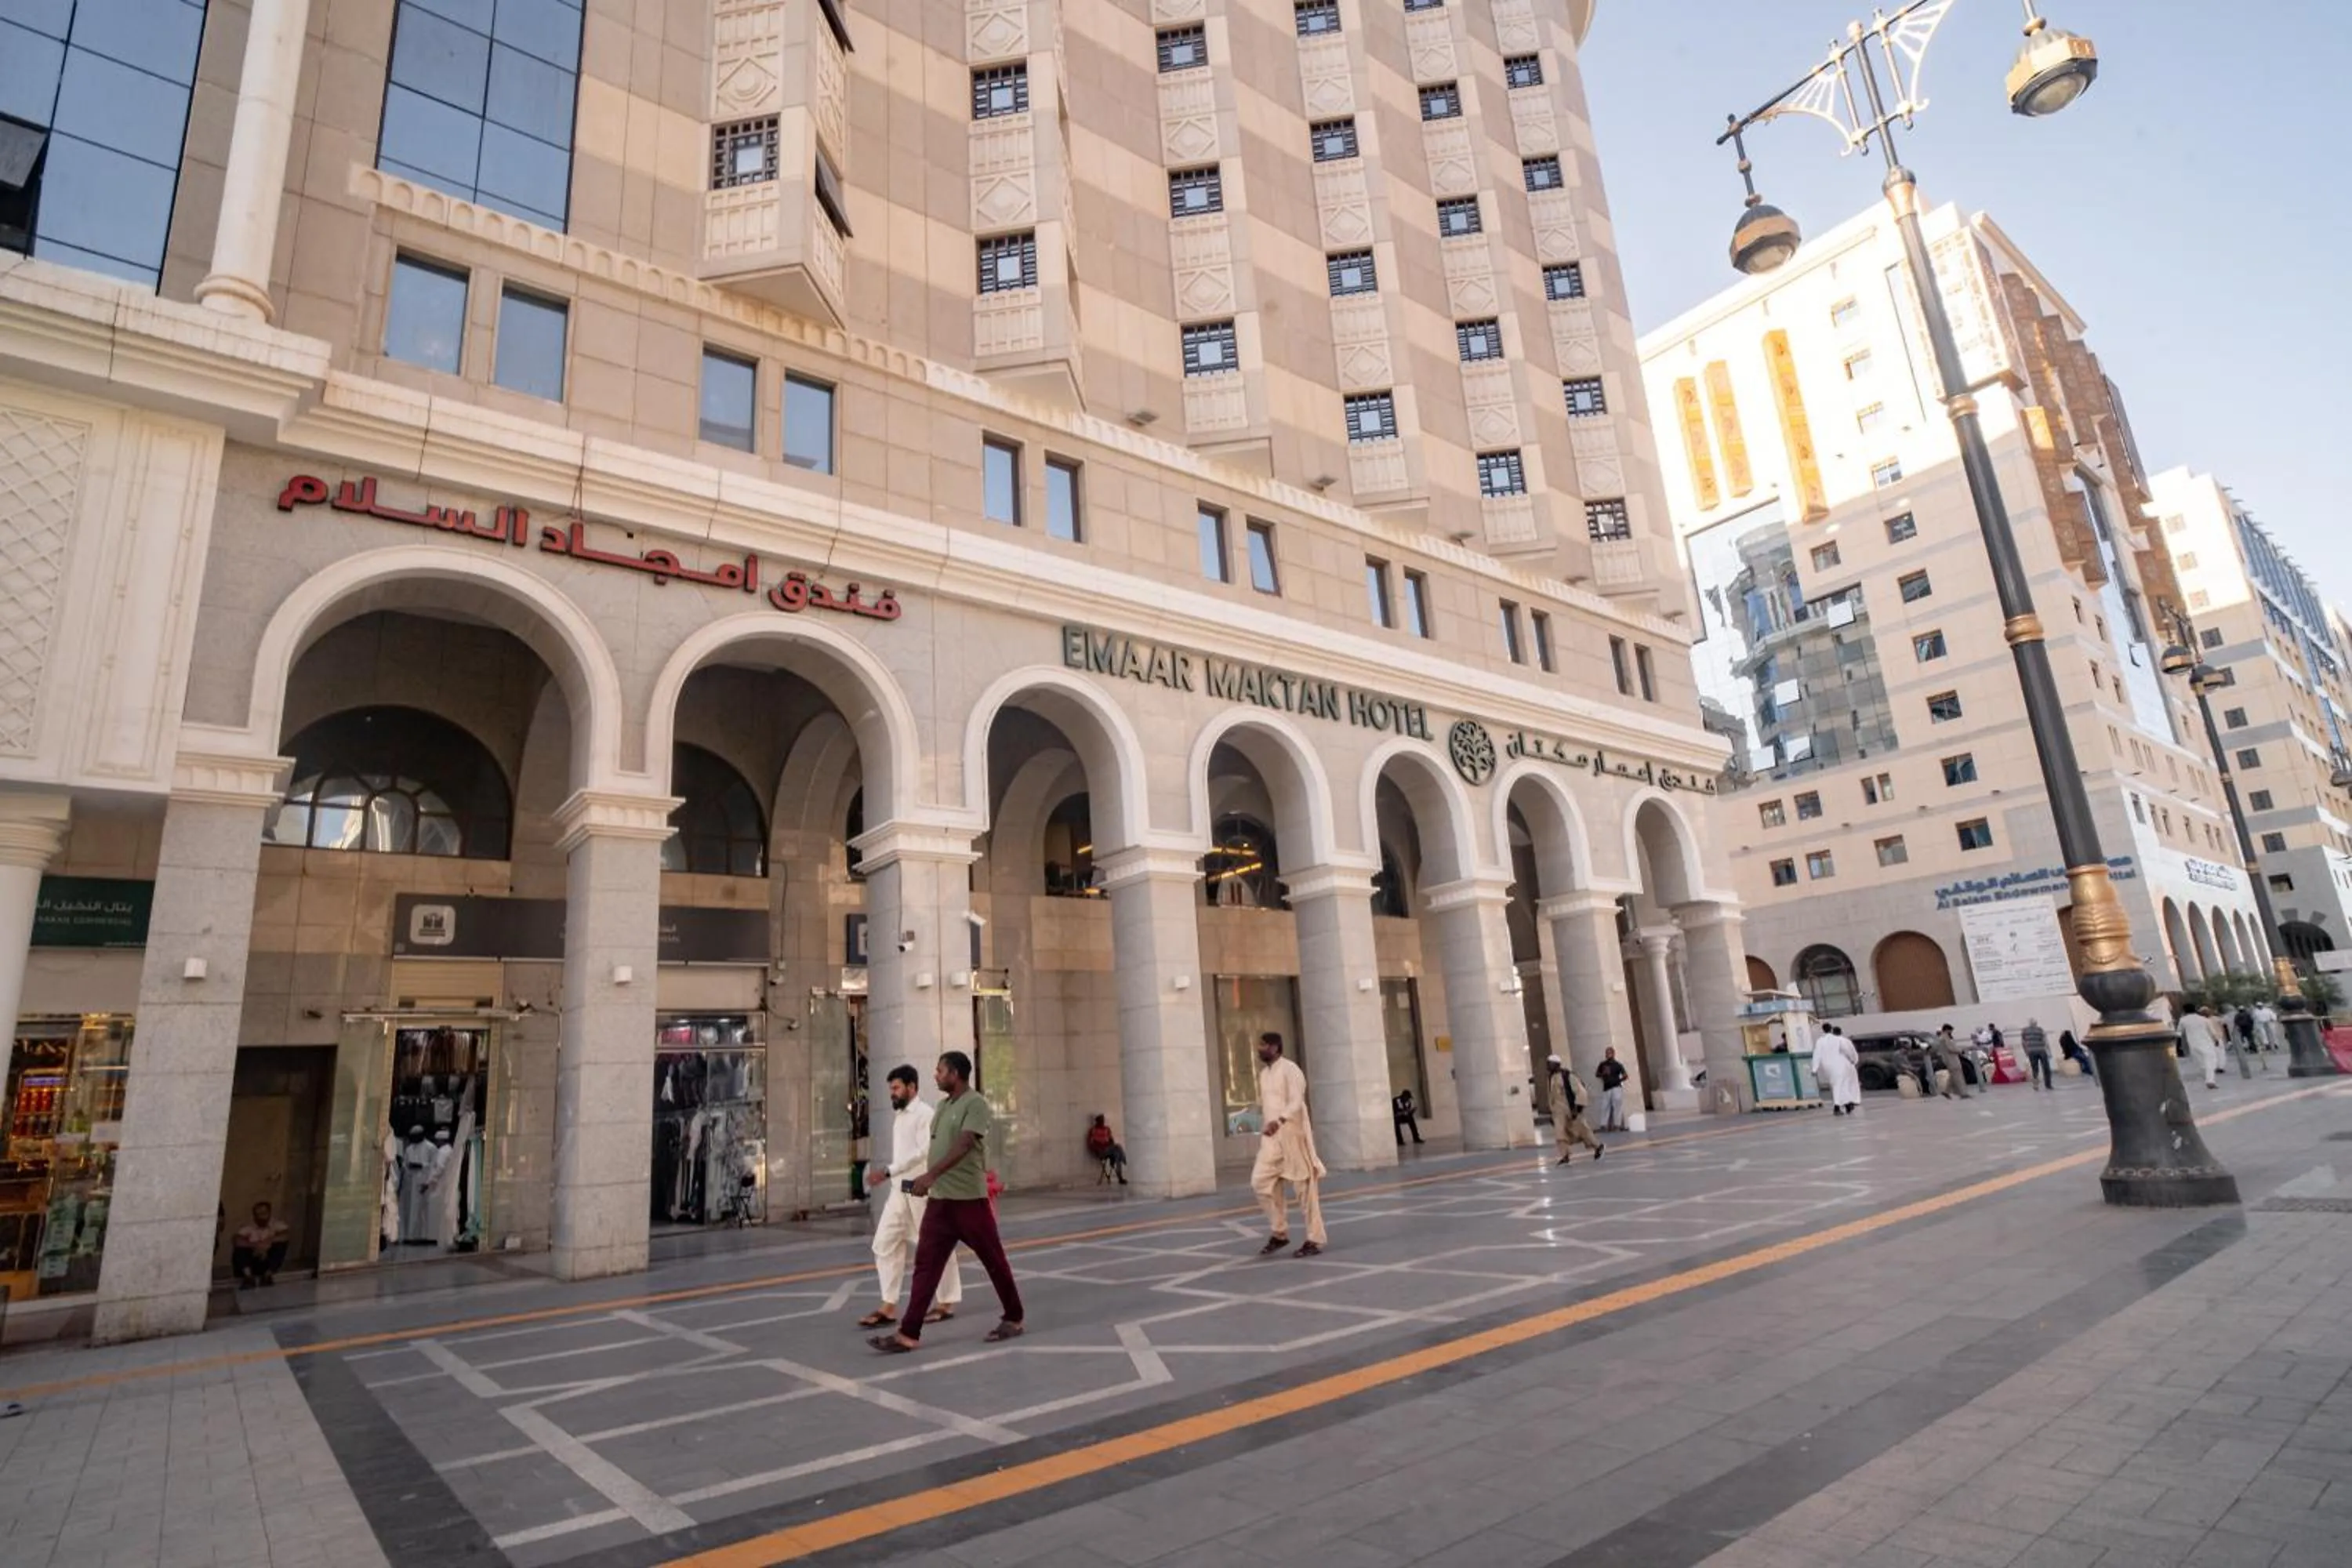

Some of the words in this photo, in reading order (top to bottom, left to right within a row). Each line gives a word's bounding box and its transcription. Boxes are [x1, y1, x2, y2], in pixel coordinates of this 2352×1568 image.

[278, 474, 528, 547] السلام
[768, 573, 902, 621] فندق
[1062, 625, 1194, 692] EMAAR
[1205, 655, 1341, 722] MAKTAN
[1348, 689, 1435, 741] HOTEL
[1505, 730, 1589, 768] مكتان
[1658, 767, 1716, 796] فندق
[1936, 900, 1950, 910] Al
[1994, 883, 2069, 901] Endowmen
